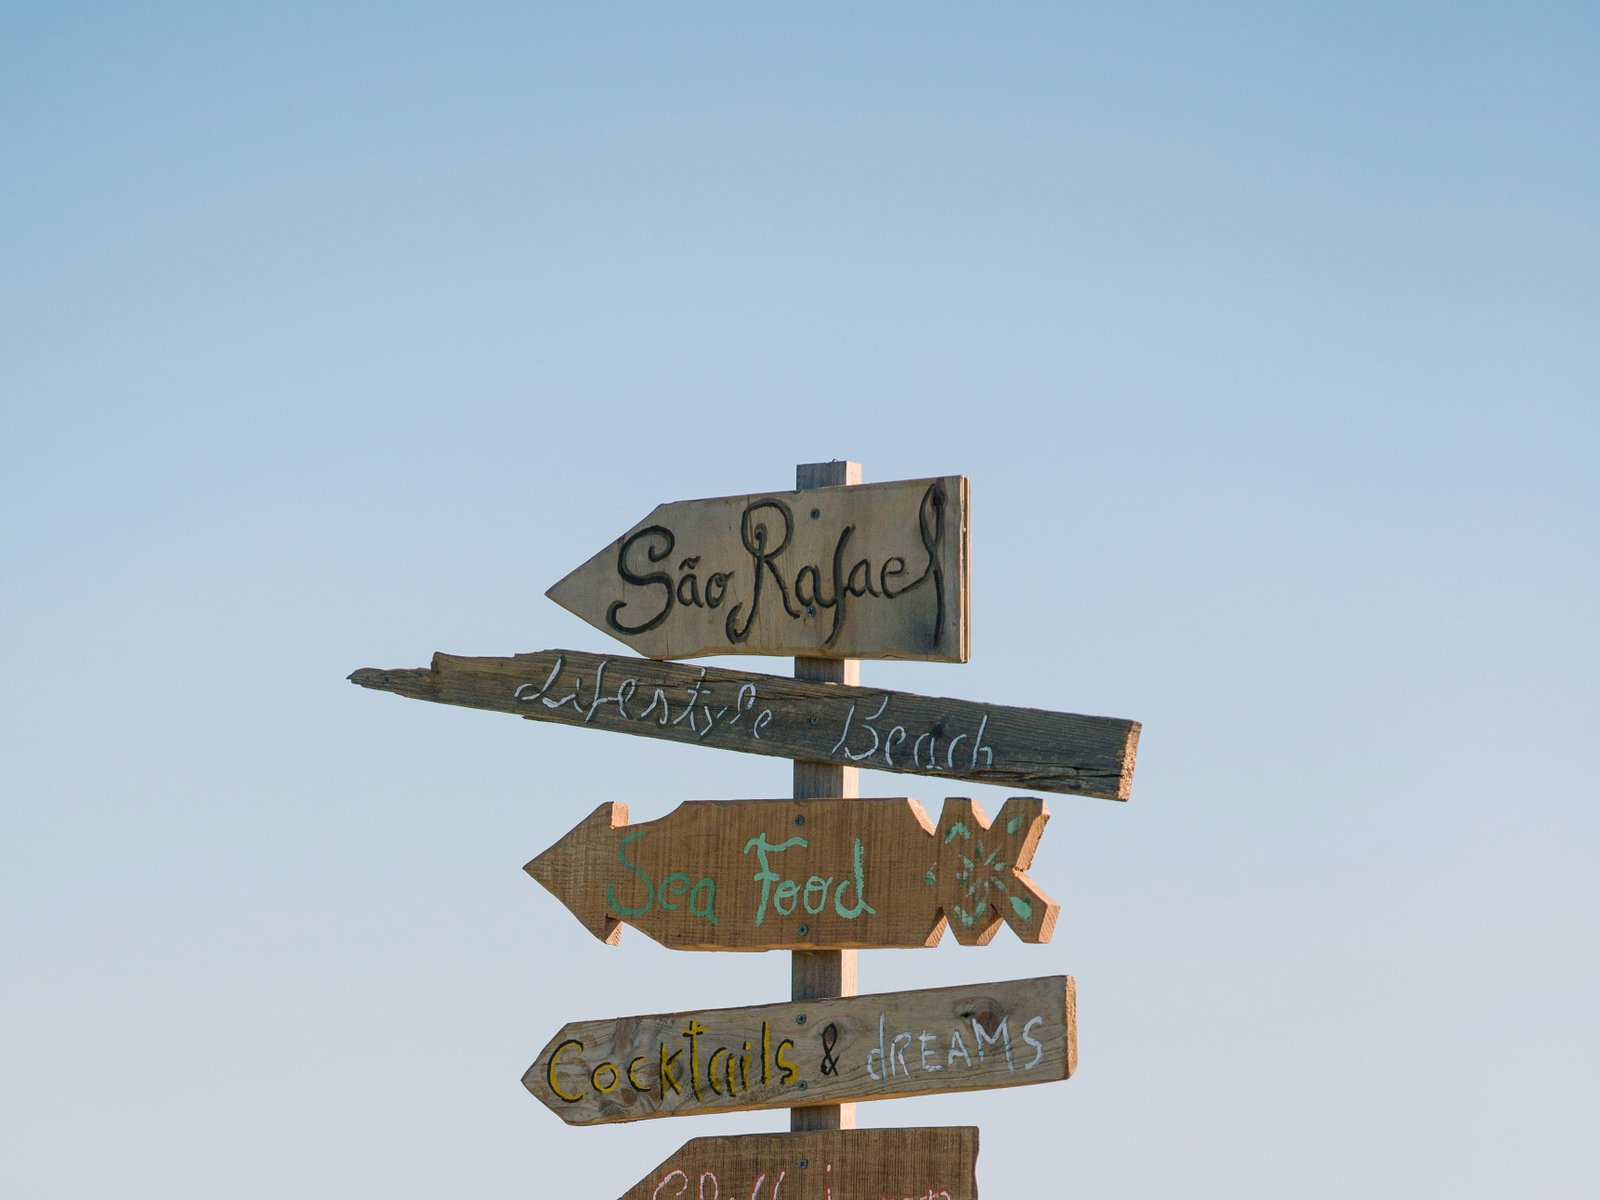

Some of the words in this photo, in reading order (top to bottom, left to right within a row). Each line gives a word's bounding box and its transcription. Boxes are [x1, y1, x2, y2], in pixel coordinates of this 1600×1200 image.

[606, 525, 734, 635] São
[725, 483, 945, 647] Rafael
[514, 656, 775, 740] Lifestyle
[831, 696, 994, 771] Beach
[607, 831, 719, 927] Sea
[743, 831, 878, 927] Food
[546, 1016, 799, 1104] Cocktails
[820, 1023, 839, 1076] &
